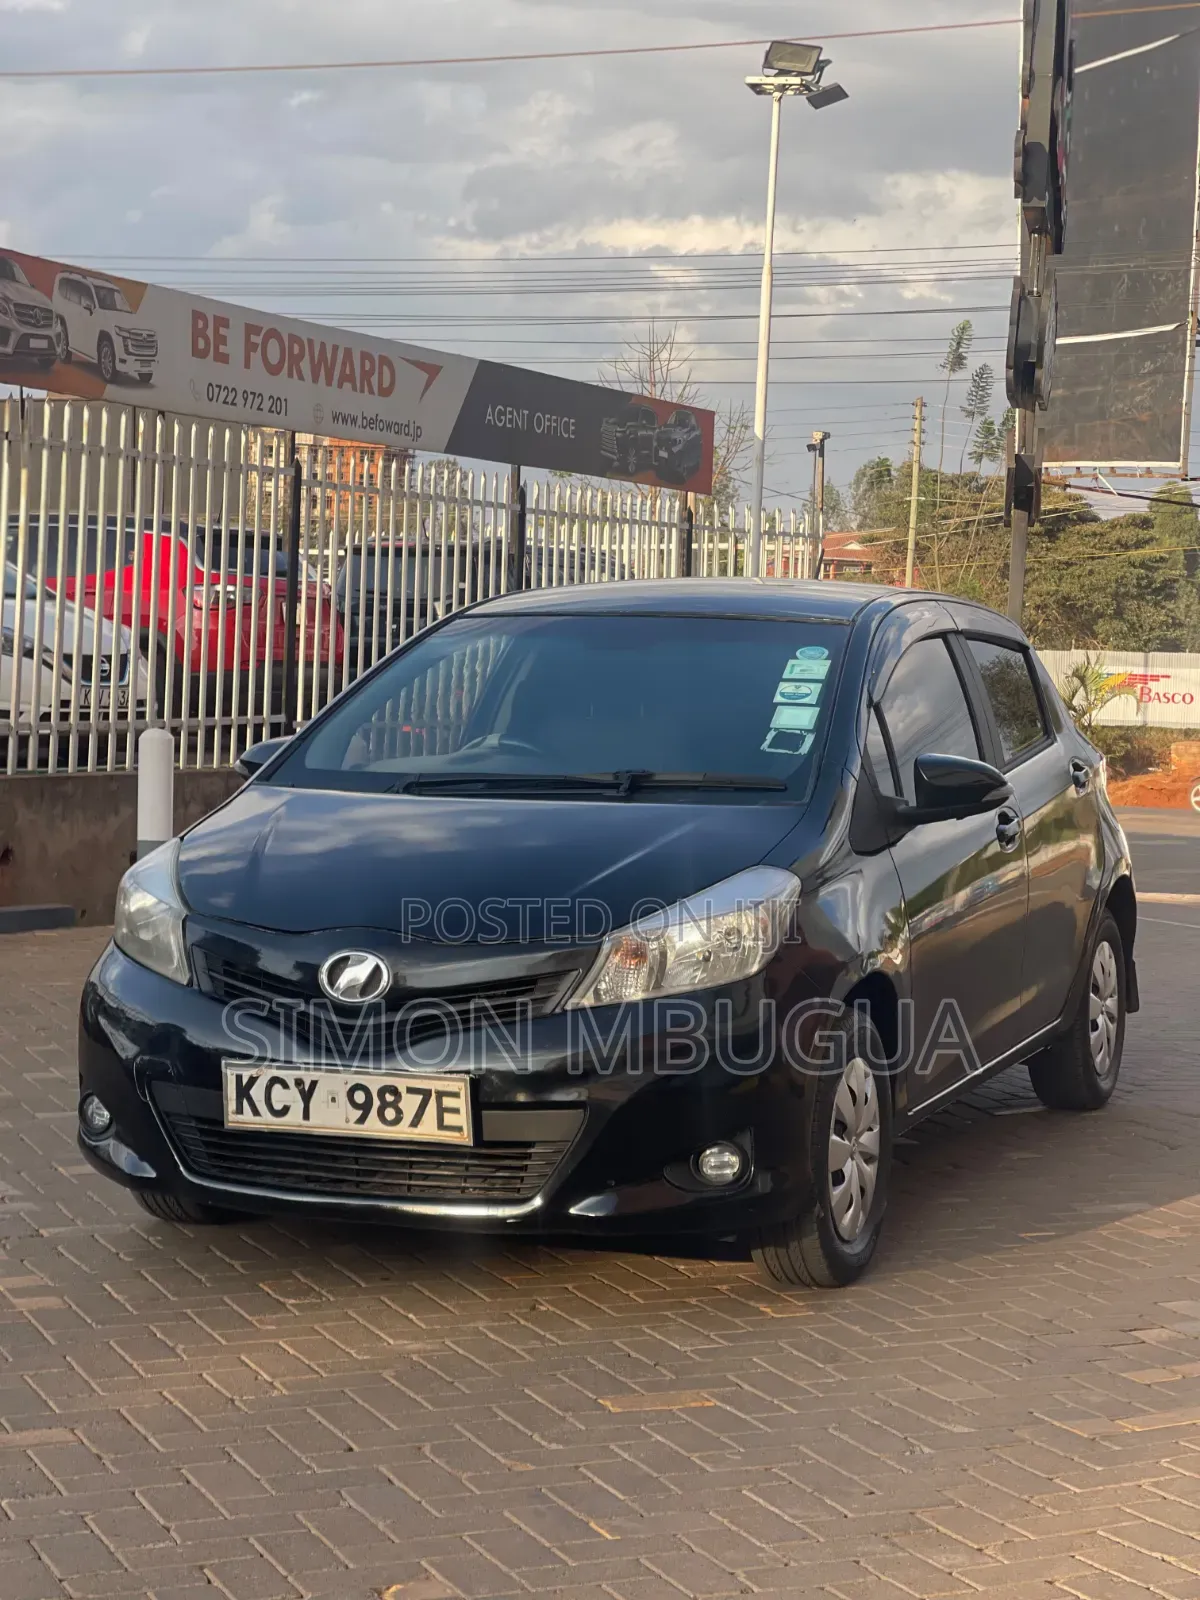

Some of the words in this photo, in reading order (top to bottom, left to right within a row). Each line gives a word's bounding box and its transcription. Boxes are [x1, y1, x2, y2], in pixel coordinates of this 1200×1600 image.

[191, 309, 230, 364] BE
[244, 322, 395, 398] FORWARD
[206, 382, 237, 407] 0722
[242, 389, 264, 412] 972
[268, 396, 288, 416] 201
[331, 409, 423, 442] www.befoward.jp
[485, 404, 529, 432] AGENT
[533, 412, 576, 439] OFFICE
[235, 1073, 318, 1121] KCY
[346, 1082, 464, 1133] 987E
